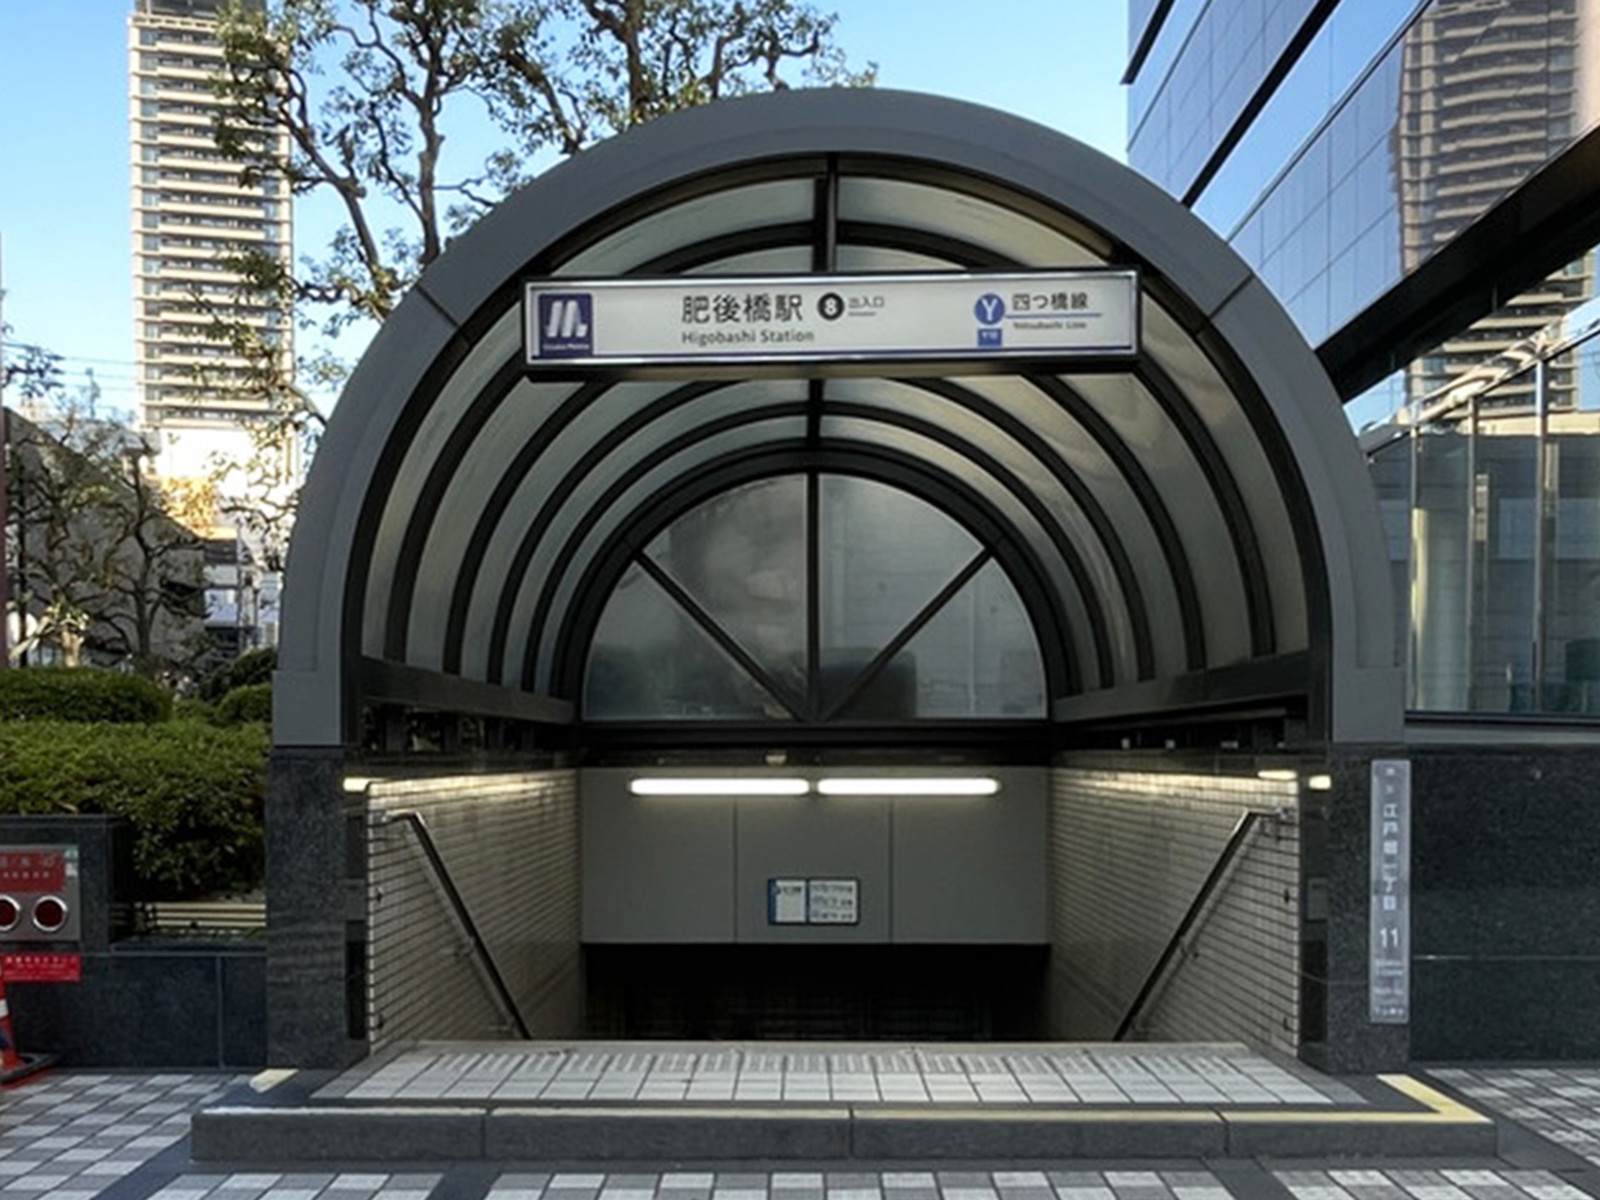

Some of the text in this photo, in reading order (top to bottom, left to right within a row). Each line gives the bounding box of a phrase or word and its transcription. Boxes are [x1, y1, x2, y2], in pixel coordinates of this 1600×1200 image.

[682, 293, 803, 323] 肥後橋駅
[1012, 292, 1089, 311] 四つ橋線
[682, 329, 815, 347] Higobashi Station
[1379, 927, 1399, 949] 11
